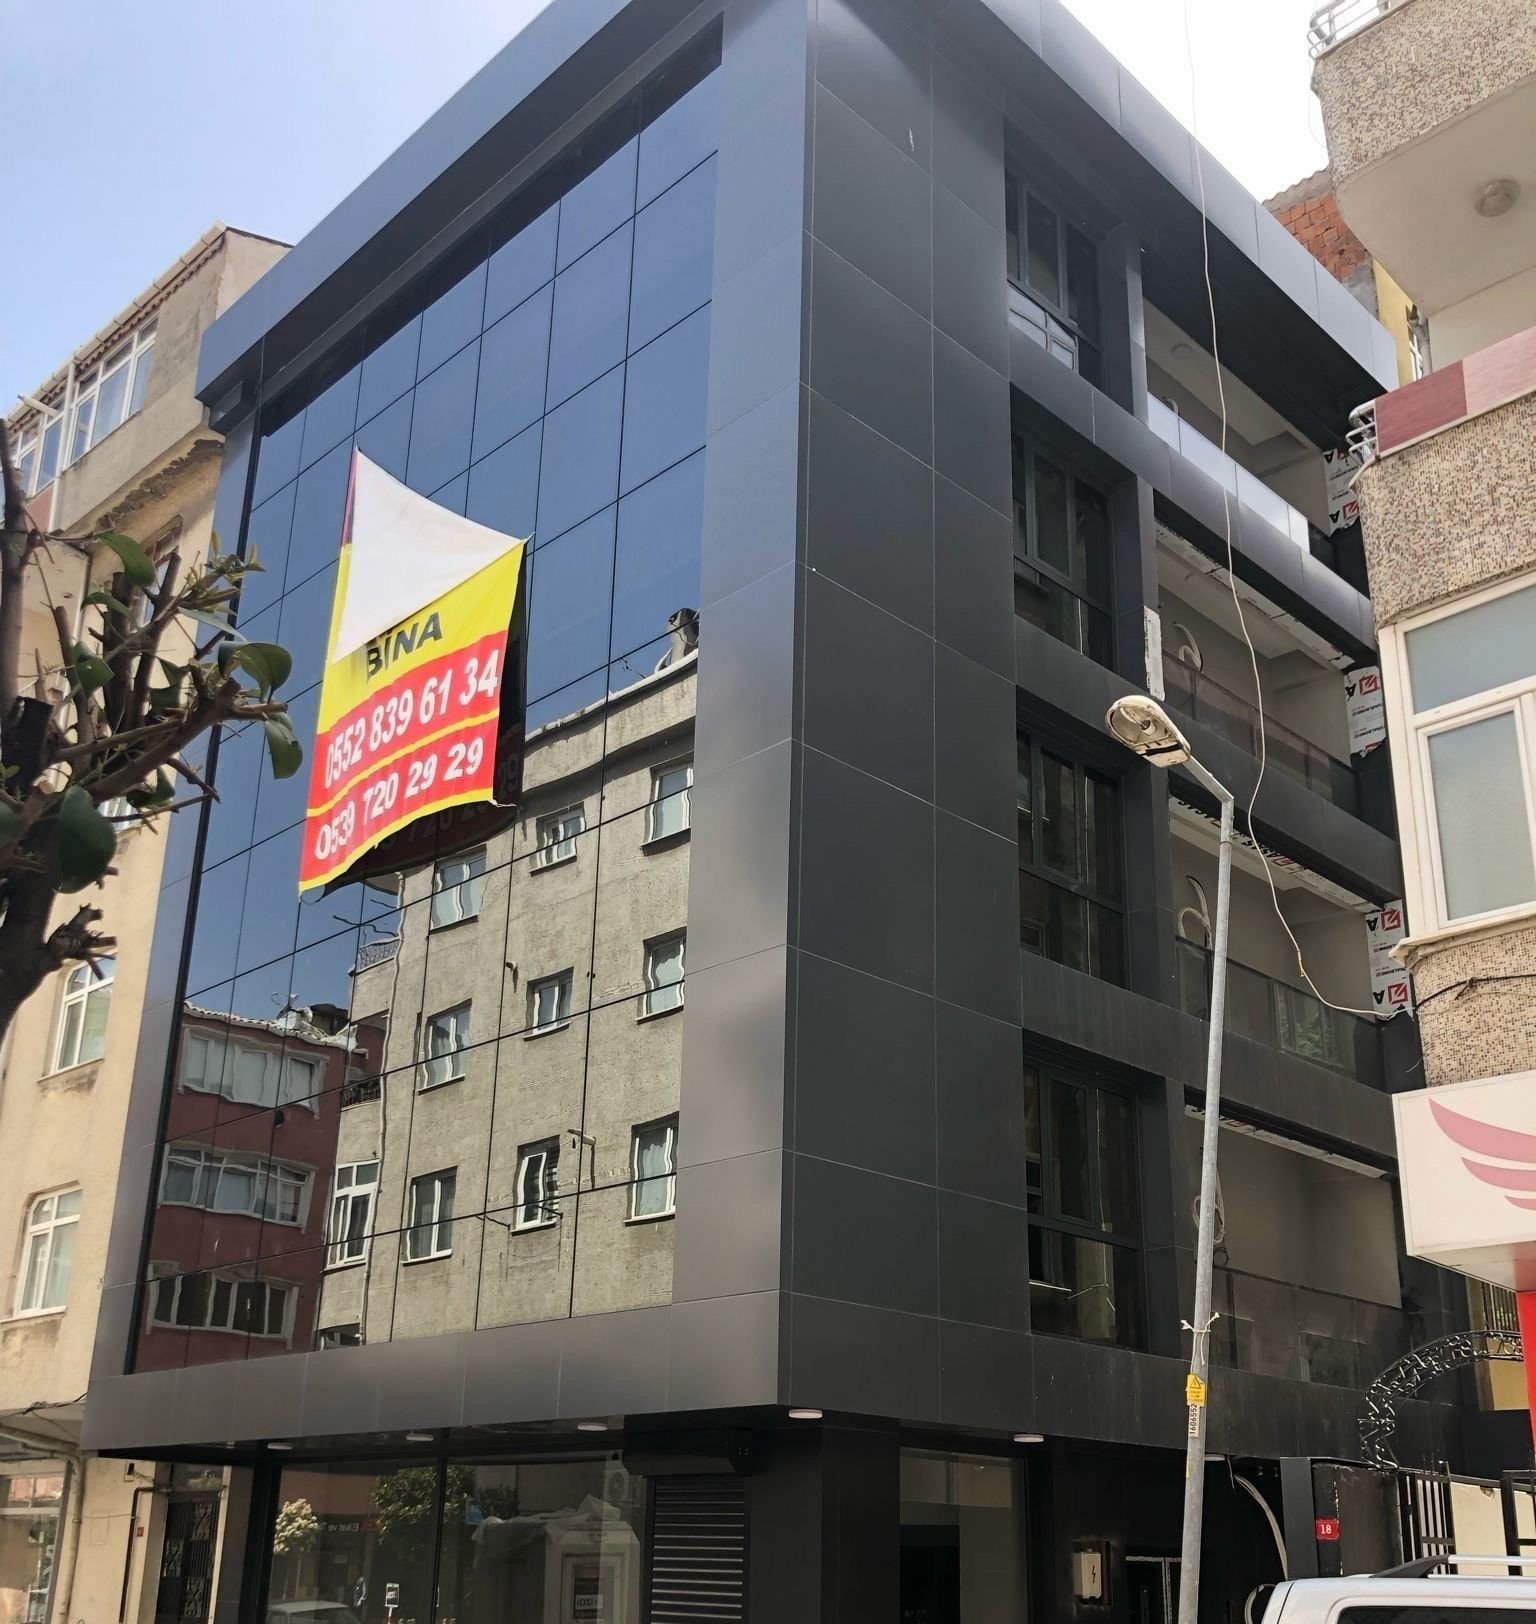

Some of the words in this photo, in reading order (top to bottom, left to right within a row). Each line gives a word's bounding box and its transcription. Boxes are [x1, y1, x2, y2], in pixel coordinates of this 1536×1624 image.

[325, 717, 366, 789] 0552
[369, 689, 414, 752] 839
[419, 669, 453, 724] 61
[459, 649, 499, 705] 34
[315, 800, 356, 860] 0539
[363, 772, 399, 826] 720
[404, 753, 438, 799] 29
[443, 737, 483, 781] 29
[1189, 1403, 1198, 1436] 1606552
[1320, 1523, 1332, 1535] 18
